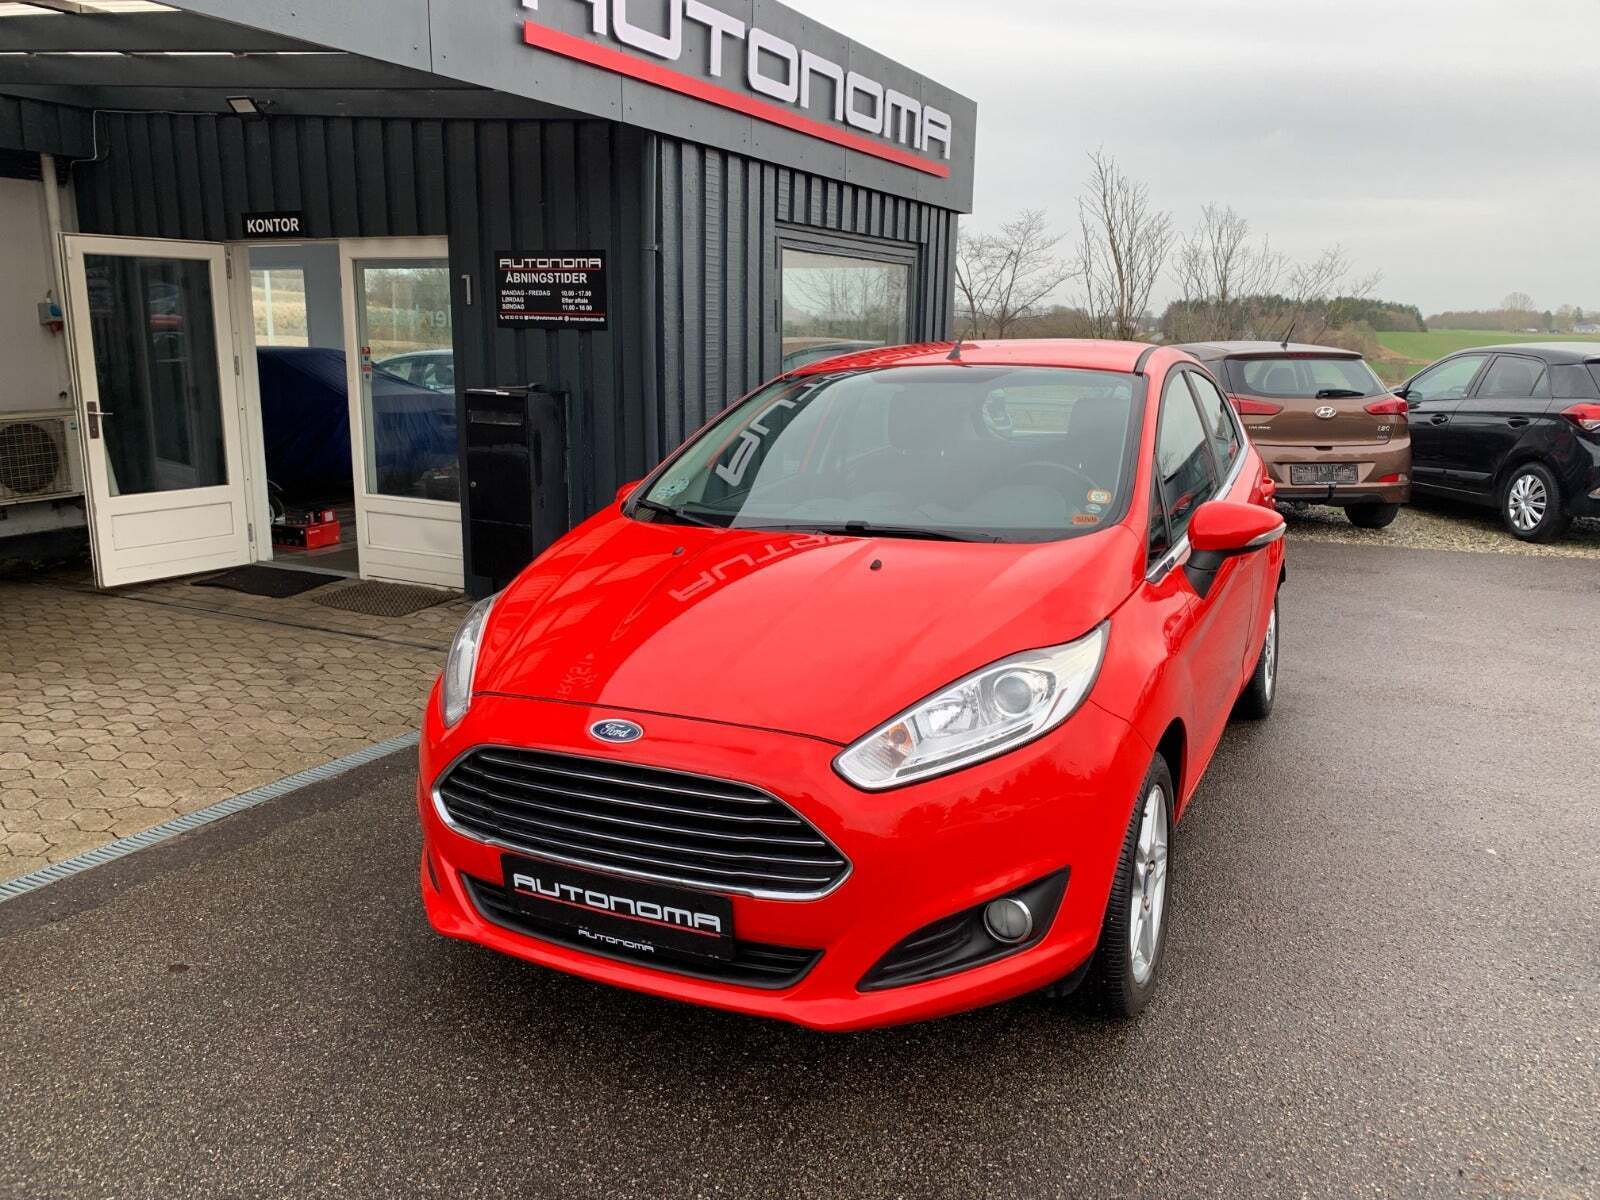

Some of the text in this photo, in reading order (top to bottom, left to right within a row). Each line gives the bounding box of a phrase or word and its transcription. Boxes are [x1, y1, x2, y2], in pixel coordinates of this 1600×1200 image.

[247, 218, 300, 233] KONTOR
[499, 258, 602, 269] AUTONOMA
[505, 271, 588, 284] ÅBNINGSTIDER
[513, 873, 721, 933] AUTONOMA
[577, 927, 655, 953] AUTONOMA
